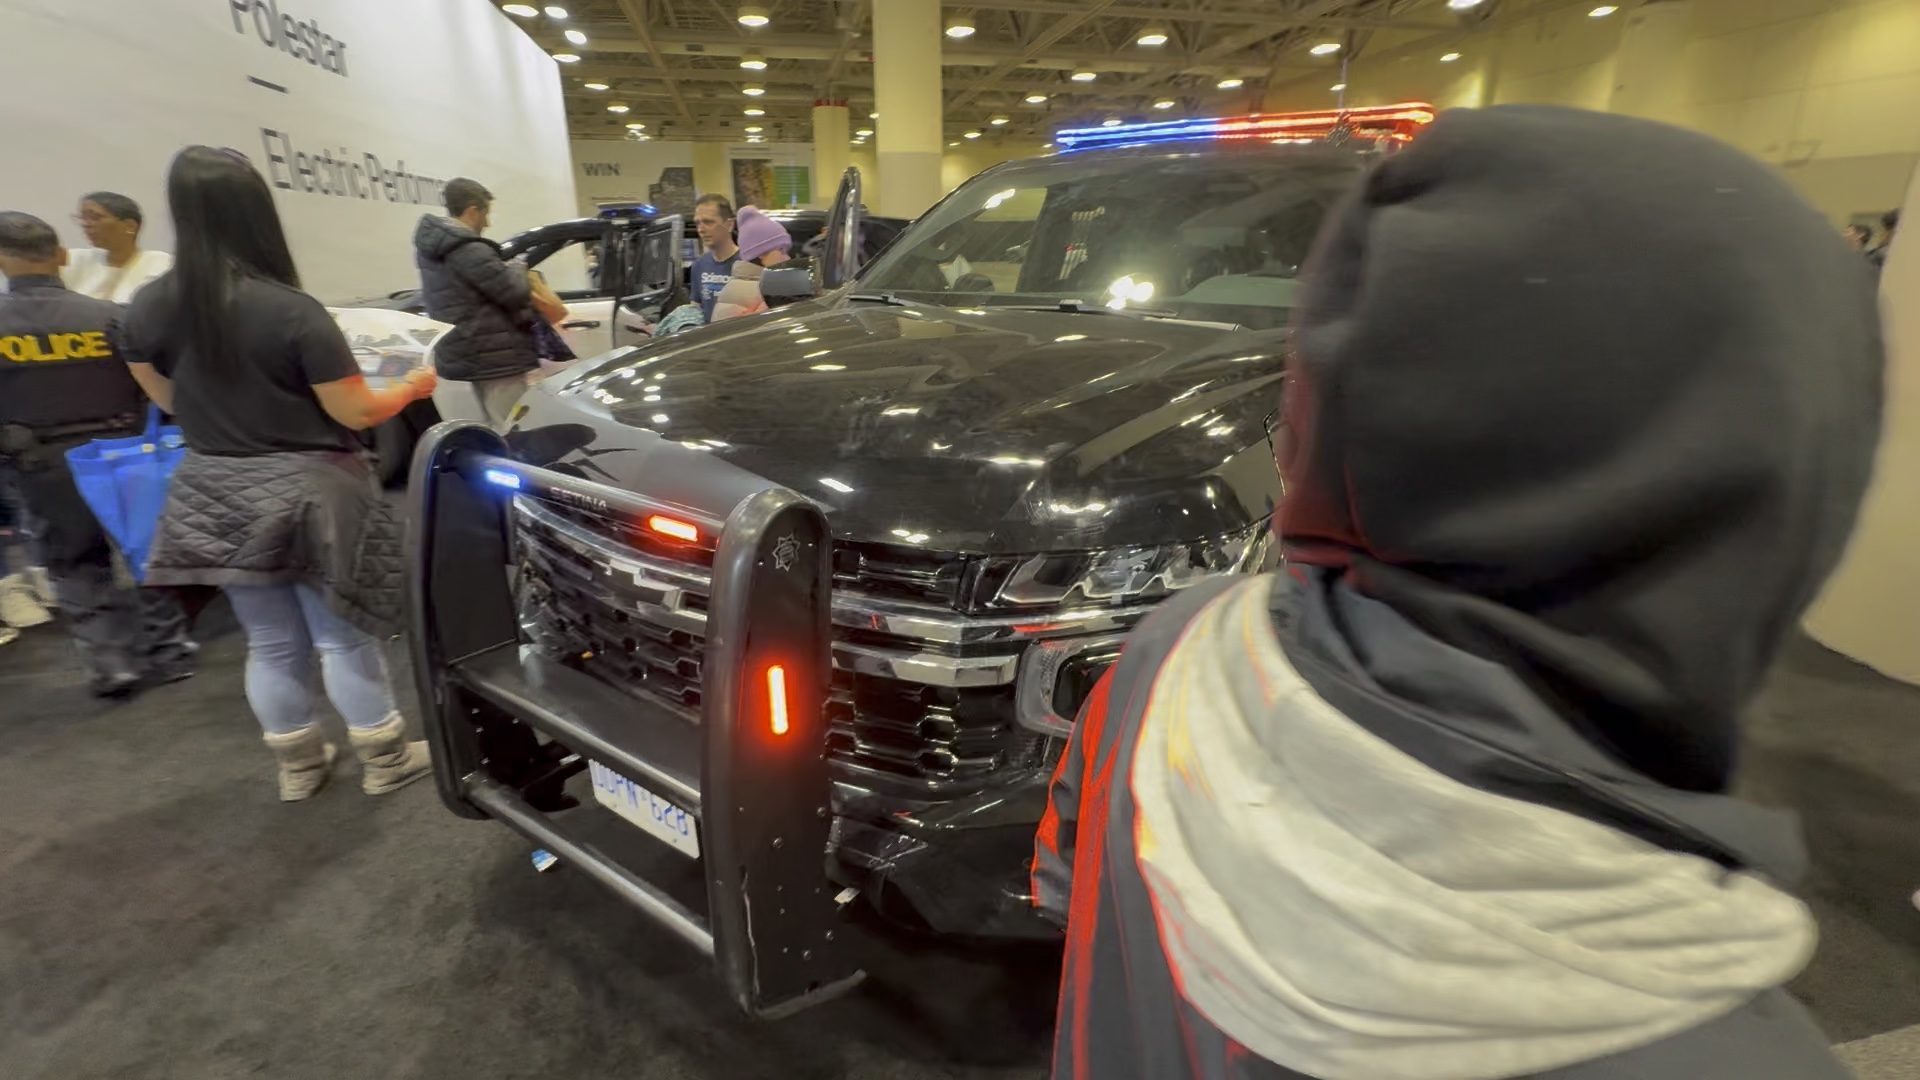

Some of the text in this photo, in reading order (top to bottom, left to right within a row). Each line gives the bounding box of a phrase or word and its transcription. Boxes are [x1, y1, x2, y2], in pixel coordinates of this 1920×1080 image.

[229, 0, 348, 77] Polestar
[260, 127, 366, 199] Electric
[581, 162, 620, 176] WIN
[701, 272, 731, 284] Scienc
[0, 332, 112, 362] OLICE
